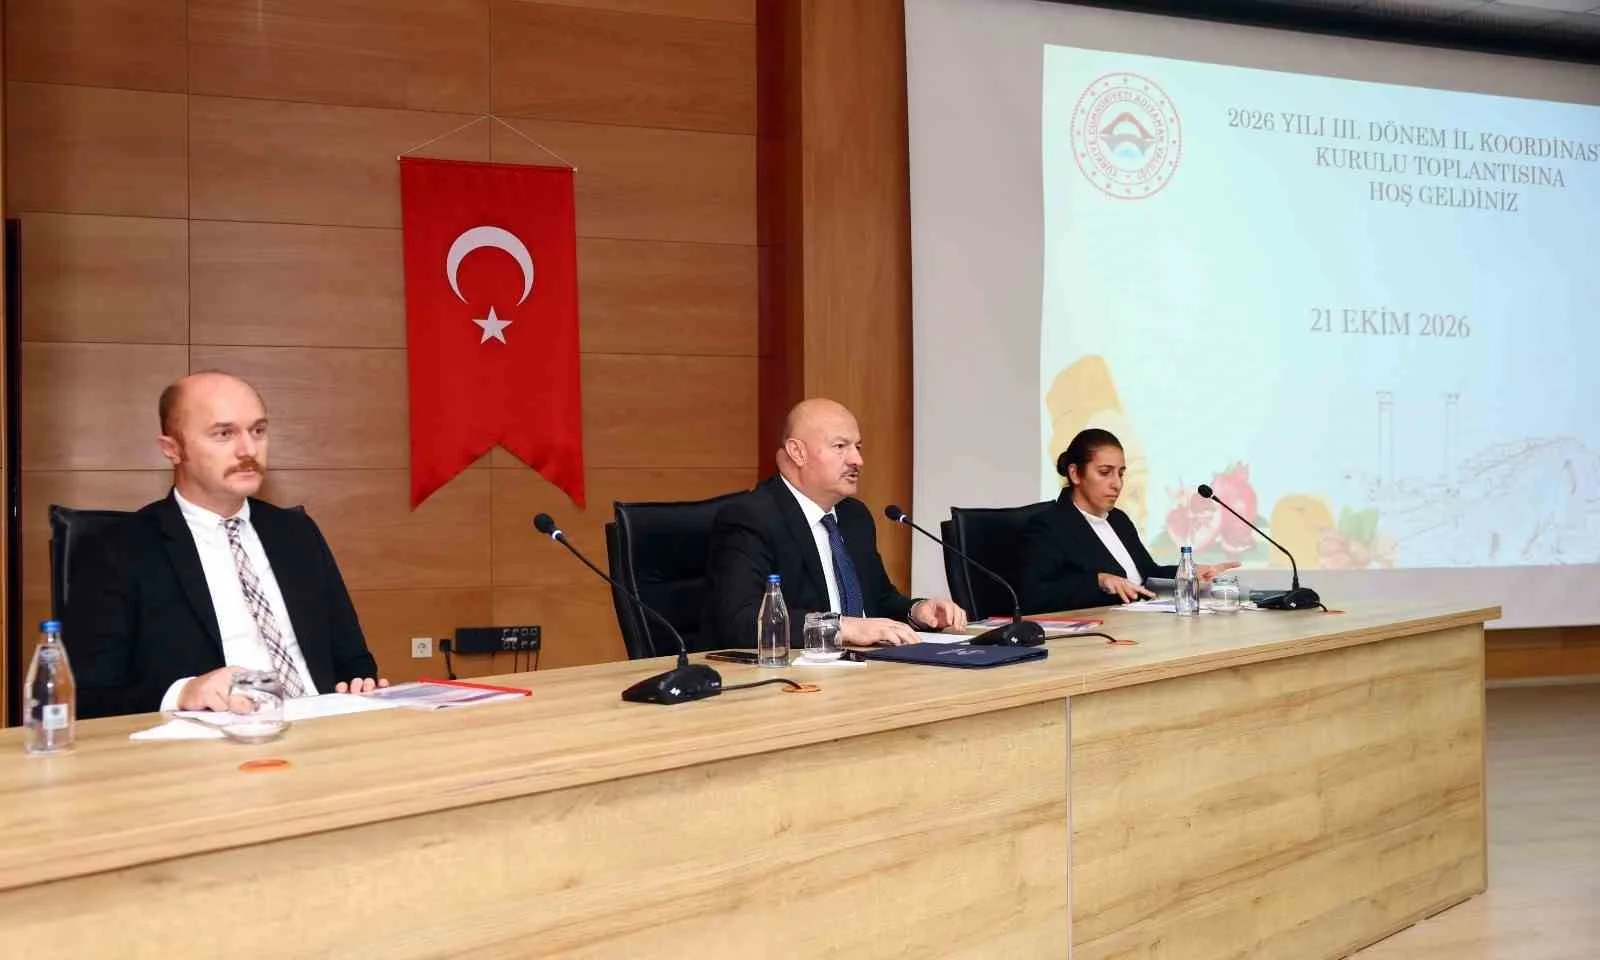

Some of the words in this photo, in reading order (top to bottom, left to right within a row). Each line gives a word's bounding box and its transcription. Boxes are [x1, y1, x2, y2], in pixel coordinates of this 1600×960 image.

[1227, 107, 1275, 131] 2026
[1281, 112, 1324, 137] YILI
[1332, 117, 1361, 140] III.
[1369, 120, 1446, 149] DÖNEM
[1454, 127, 1474, 151] İL
[1480, 132, 1600, 162] KOORDİNAS
[1315, 146, 1407, 174] KURULU
[1414, 155, 1568, 188] TOPLANTISINA
[1369, 181, 1413, 208] HOŞ
[1418, 185, 1520, 213] GELDİNİZ
[1310, 307, 1333, 333] 21
[1342, 306, 1411, 336] EKİM
[1419, 312, 1471, 339] 2026
